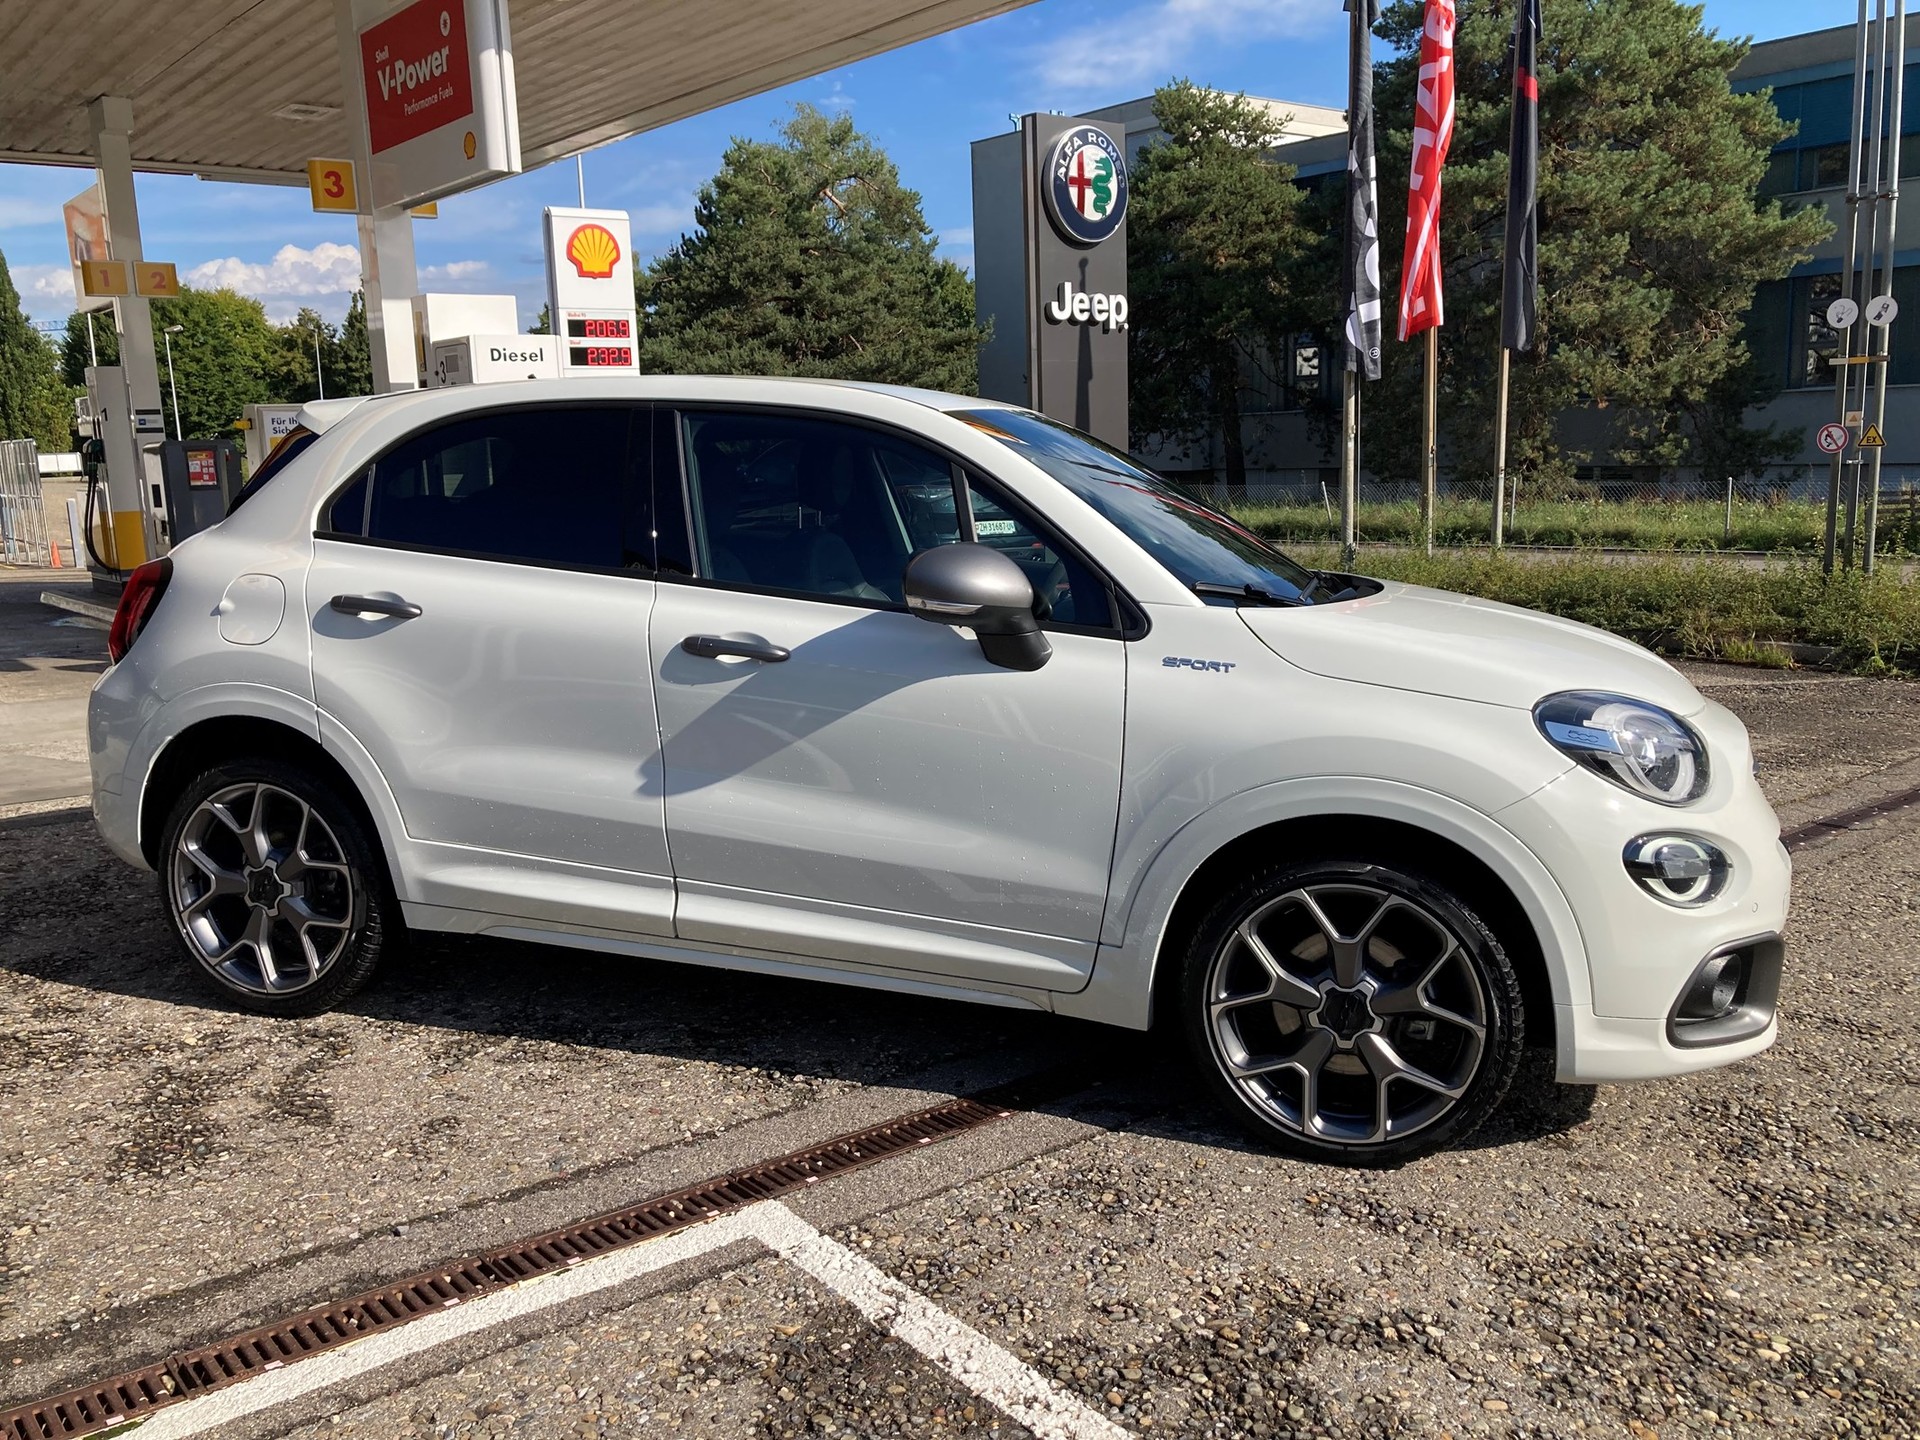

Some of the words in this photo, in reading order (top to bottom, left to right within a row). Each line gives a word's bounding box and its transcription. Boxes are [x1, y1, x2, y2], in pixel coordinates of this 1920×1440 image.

[375, 45, 389, 64] Shell
[377, 45, 449, 101] V-Power
[404, 98, 438, 116] Performance
[438, 82, 454, 100] Fuels
[1057, 136, 1083, 182] ALFA
[1087, 131, 1126, 189] ROMEO
[324, 170, 345, 198] 3
[100, 269, 110, 288] 1
[150, 271, 166, 289] 2
[1051, 281, 1128, 330] Jeep
[585, 320, 630, 338] 206.9
[489, 347, 544, 362] Diesel
[587, 347, 632, 366] 232.9
[440, 360, 447, 384] 3
[101, 407, 108, 422] 1
[271, 417, 286, 425] Für
[289, 417, 299, 425] Ih
[1866, 435, 1877, 444] EX
[1161, 656, 1236, 674] SPORT
